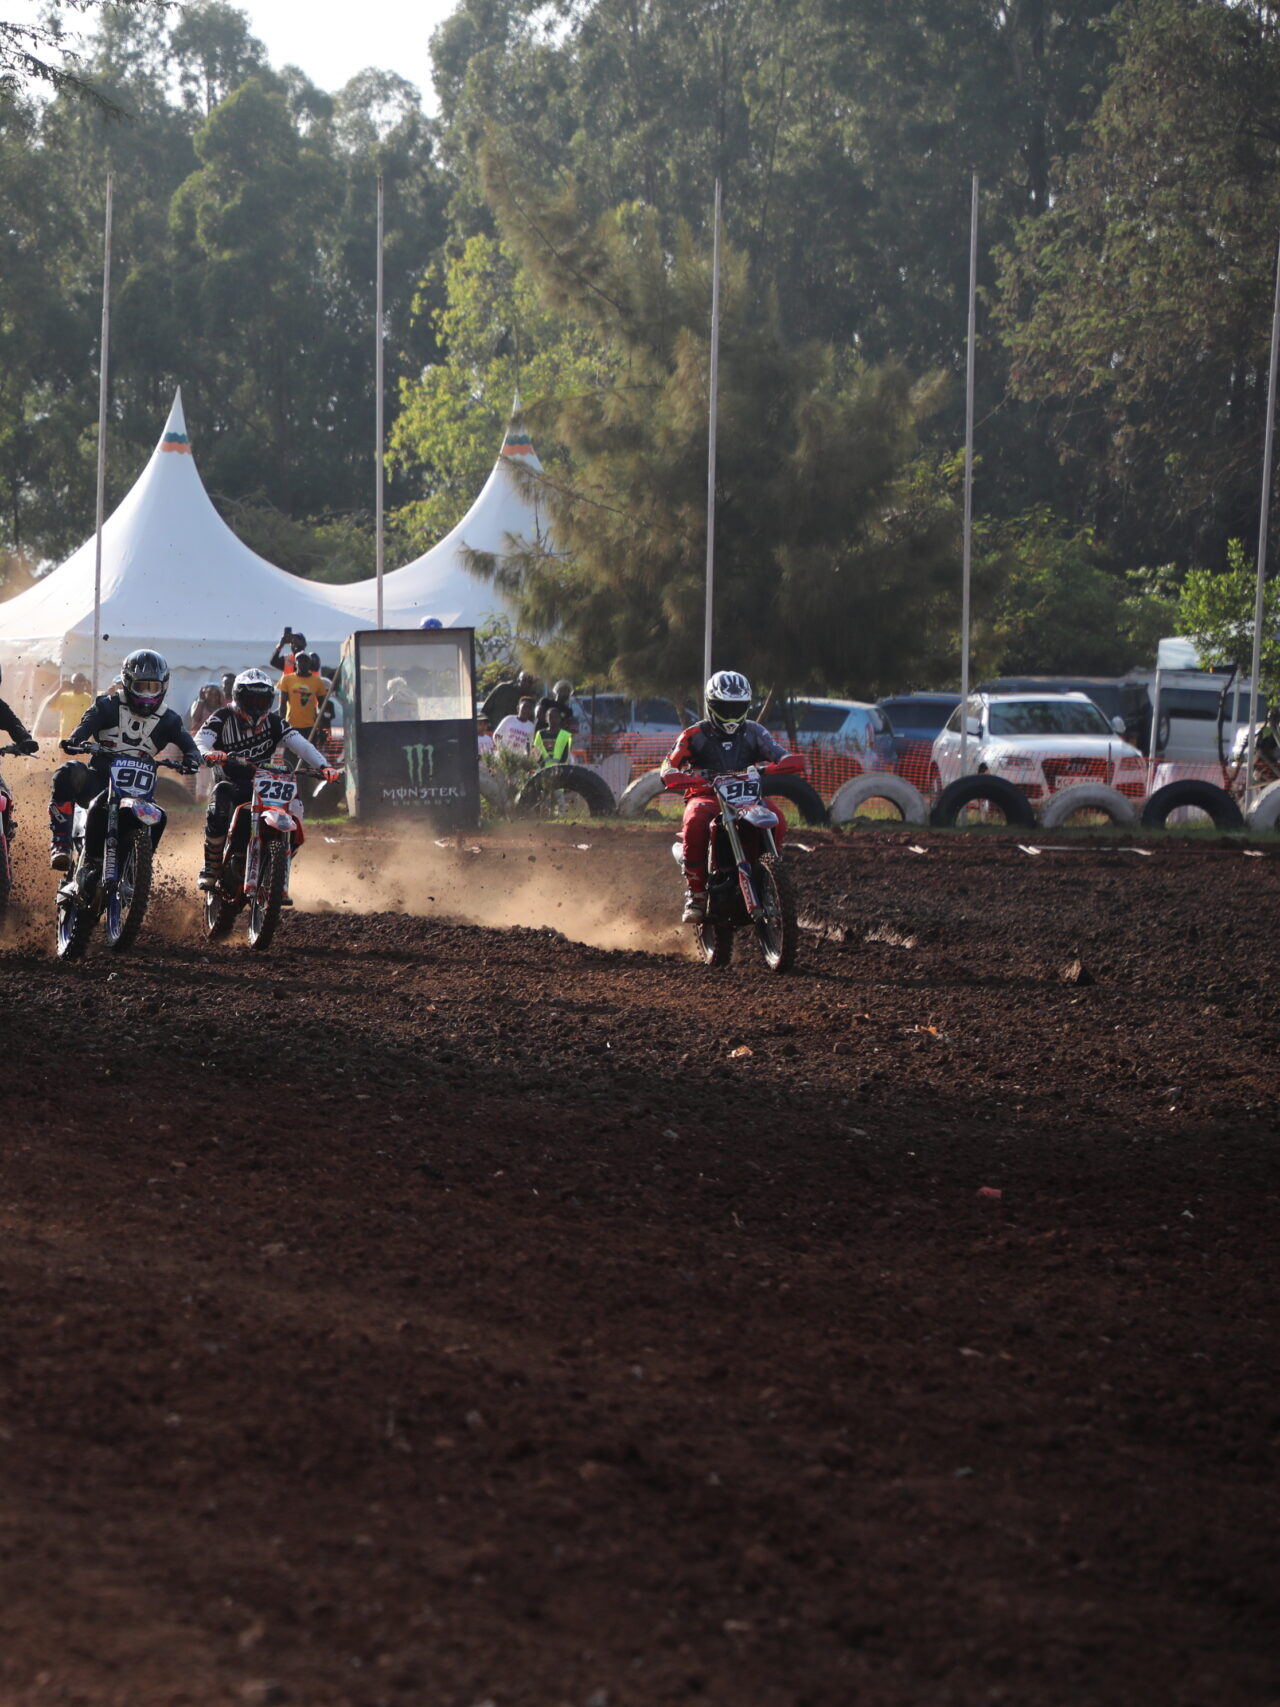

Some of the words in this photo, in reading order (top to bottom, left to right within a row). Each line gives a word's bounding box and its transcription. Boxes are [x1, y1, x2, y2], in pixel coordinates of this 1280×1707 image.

[116, 759, 153, 771] MBUKI
[116, 769, 153, 791] 90
[259, 780, 294, 801] 238
[383, 786, 458, 799] MONSTER
[105, 847, 117, 879] YAMAHA
